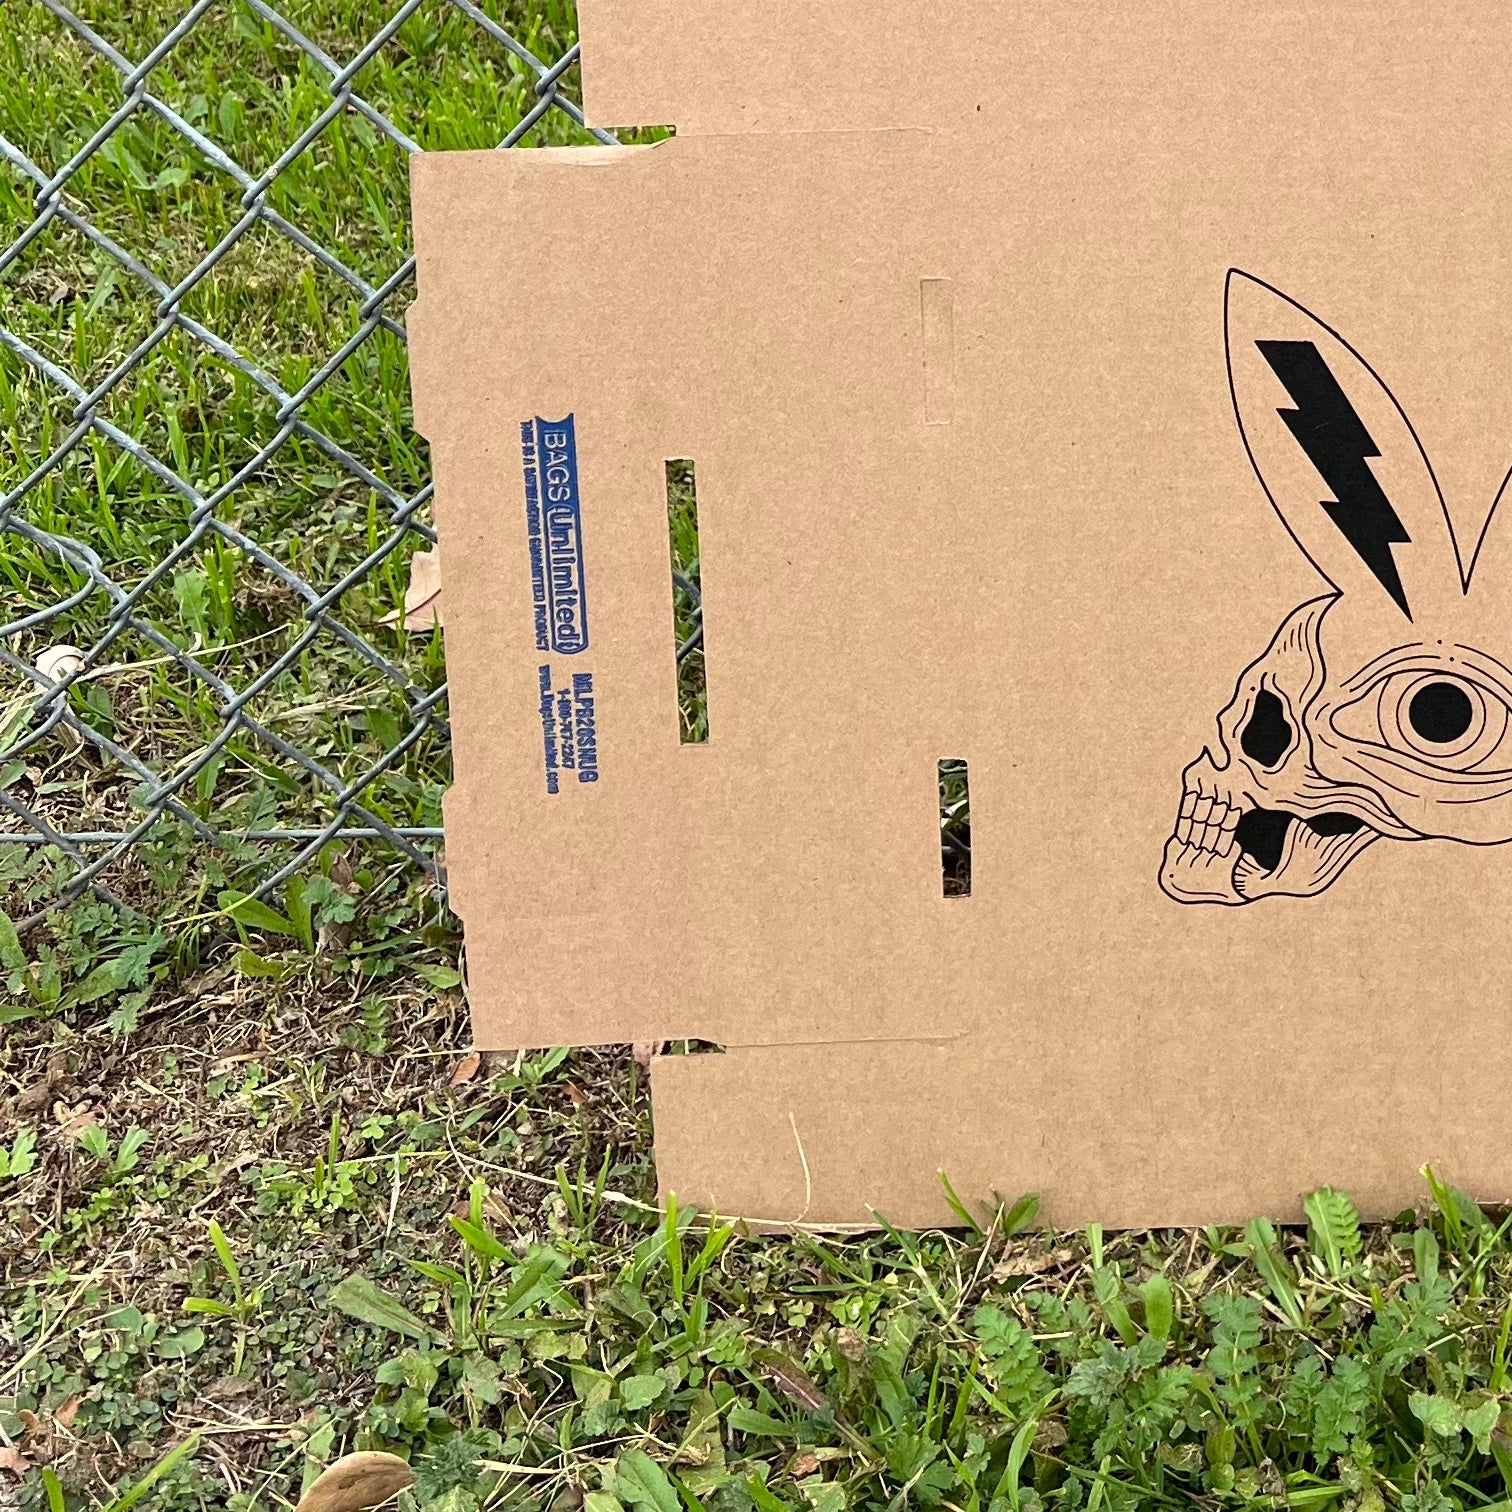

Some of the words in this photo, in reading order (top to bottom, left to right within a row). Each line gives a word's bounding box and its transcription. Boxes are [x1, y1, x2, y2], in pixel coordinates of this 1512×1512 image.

[543, 430, 571, 502] BAGS
[550, 509, 580, 641] Unlimited
[534, 604, 549, 651] PRODUCT
